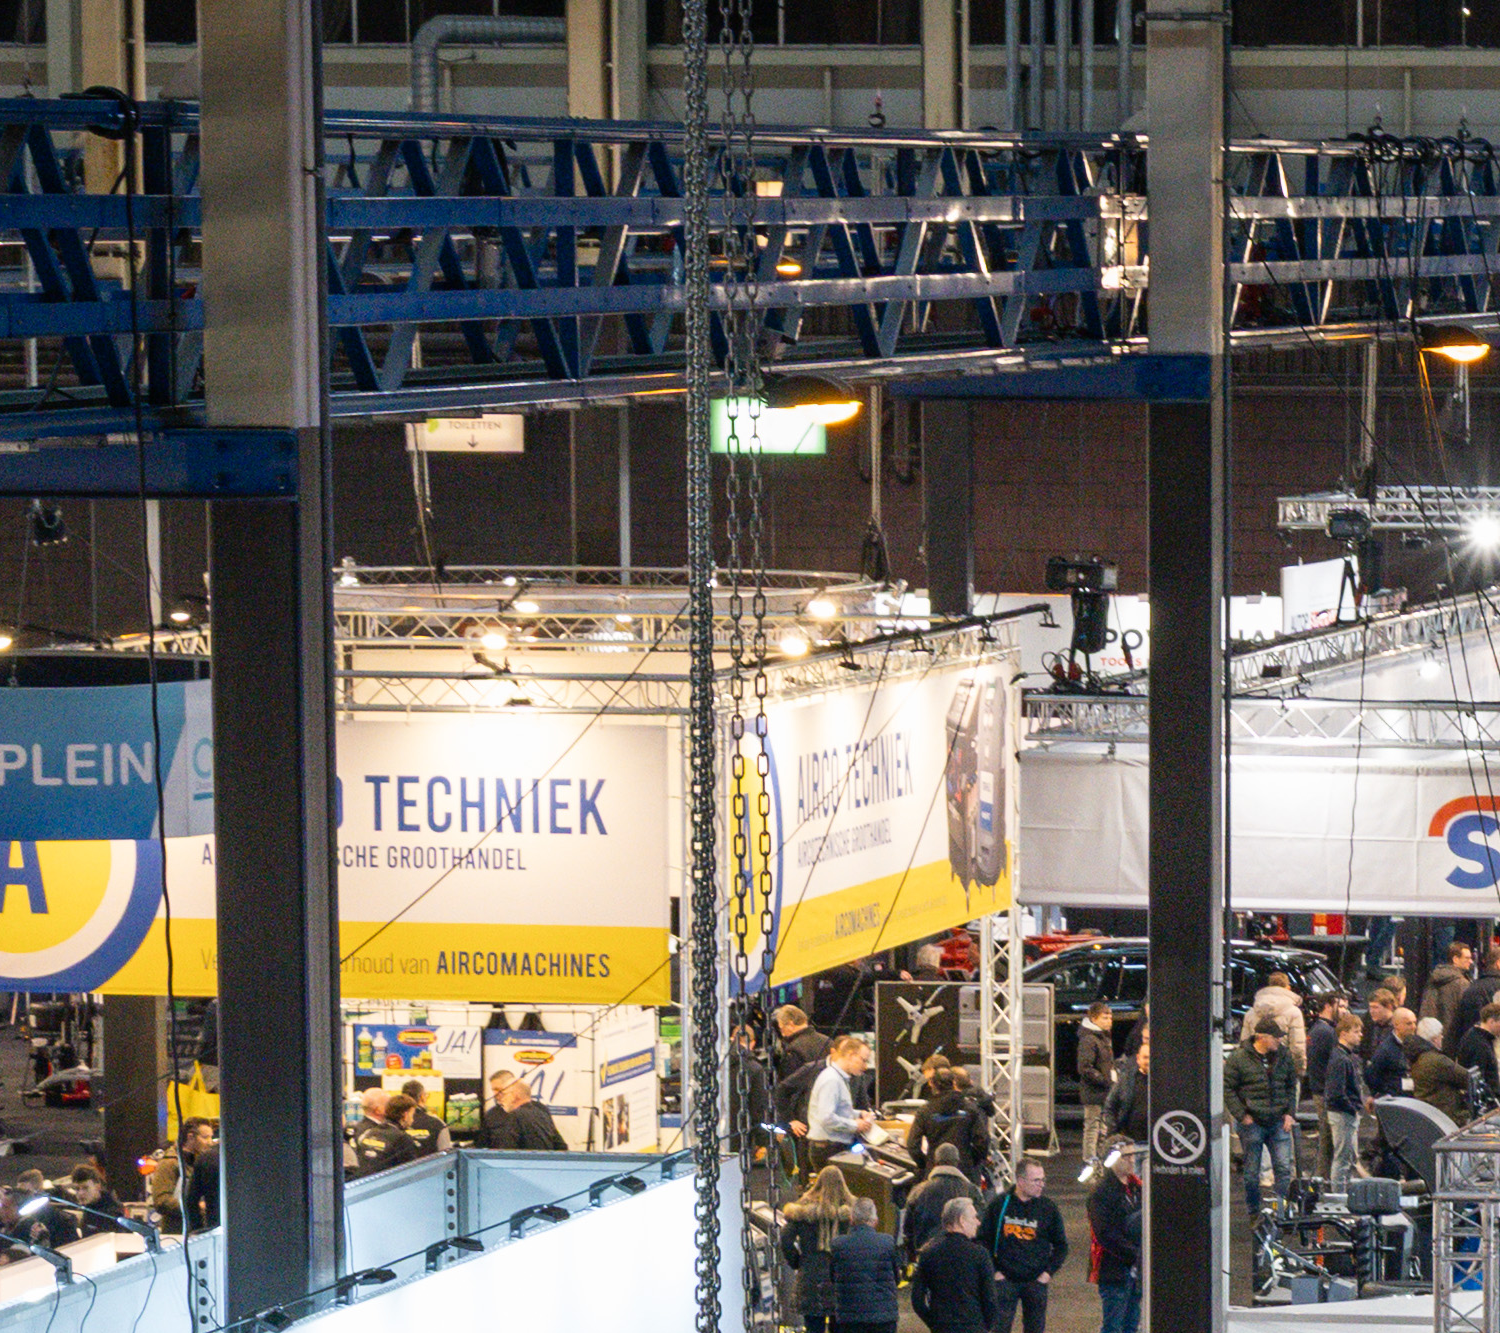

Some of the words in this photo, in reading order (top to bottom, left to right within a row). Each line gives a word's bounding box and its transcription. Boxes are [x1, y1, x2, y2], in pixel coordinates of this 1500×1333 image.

[797, 746, 842, 824] AIRCO
[846, 729, 913, 811] TECHNIEK
[364, 775, 607, 835] TECHNIEK
[386, 845, 526, 870] GROOTHANDEL
[398, 958, 431, 977] van
[437, 951, 610, 978] AIRCOMACHINES
[436, 1030, 478, 1054] JA!
